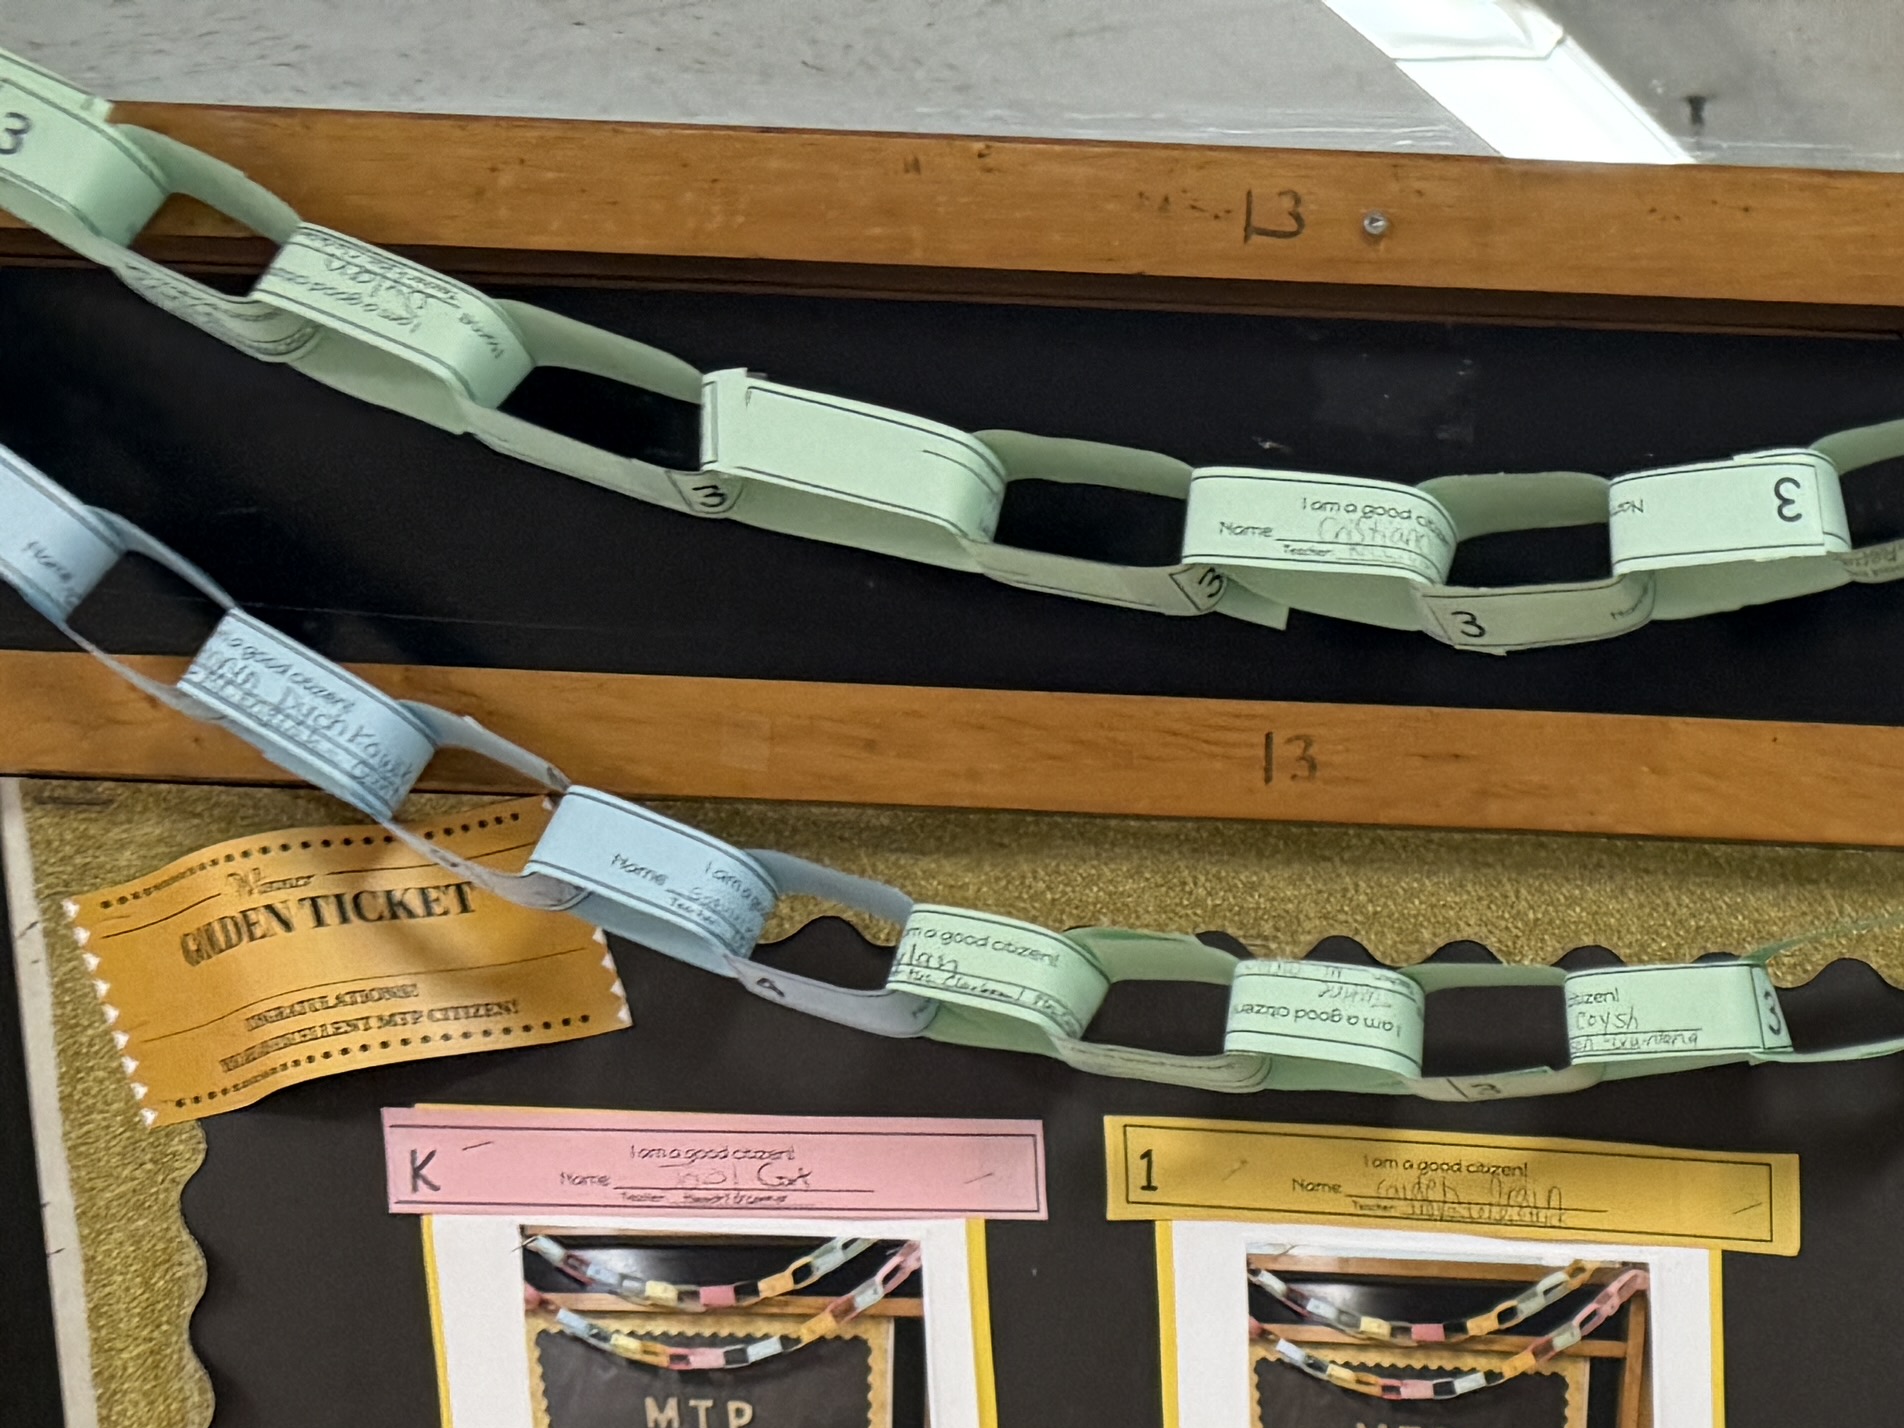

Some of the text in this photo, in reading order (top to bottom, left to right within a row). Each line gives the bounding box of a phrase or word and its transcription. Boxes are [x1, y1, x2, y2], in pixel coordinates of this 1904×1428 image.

[1773, 476, 1804, 523] 3
[1451, 611, 1486, 638] 3
[1262, 731, 1318, 786] 13
[299, 882, 477, 929] TICKET
[409, 1149, 441, 1193] K
[1137, 1148, 1158, 1192] 1
